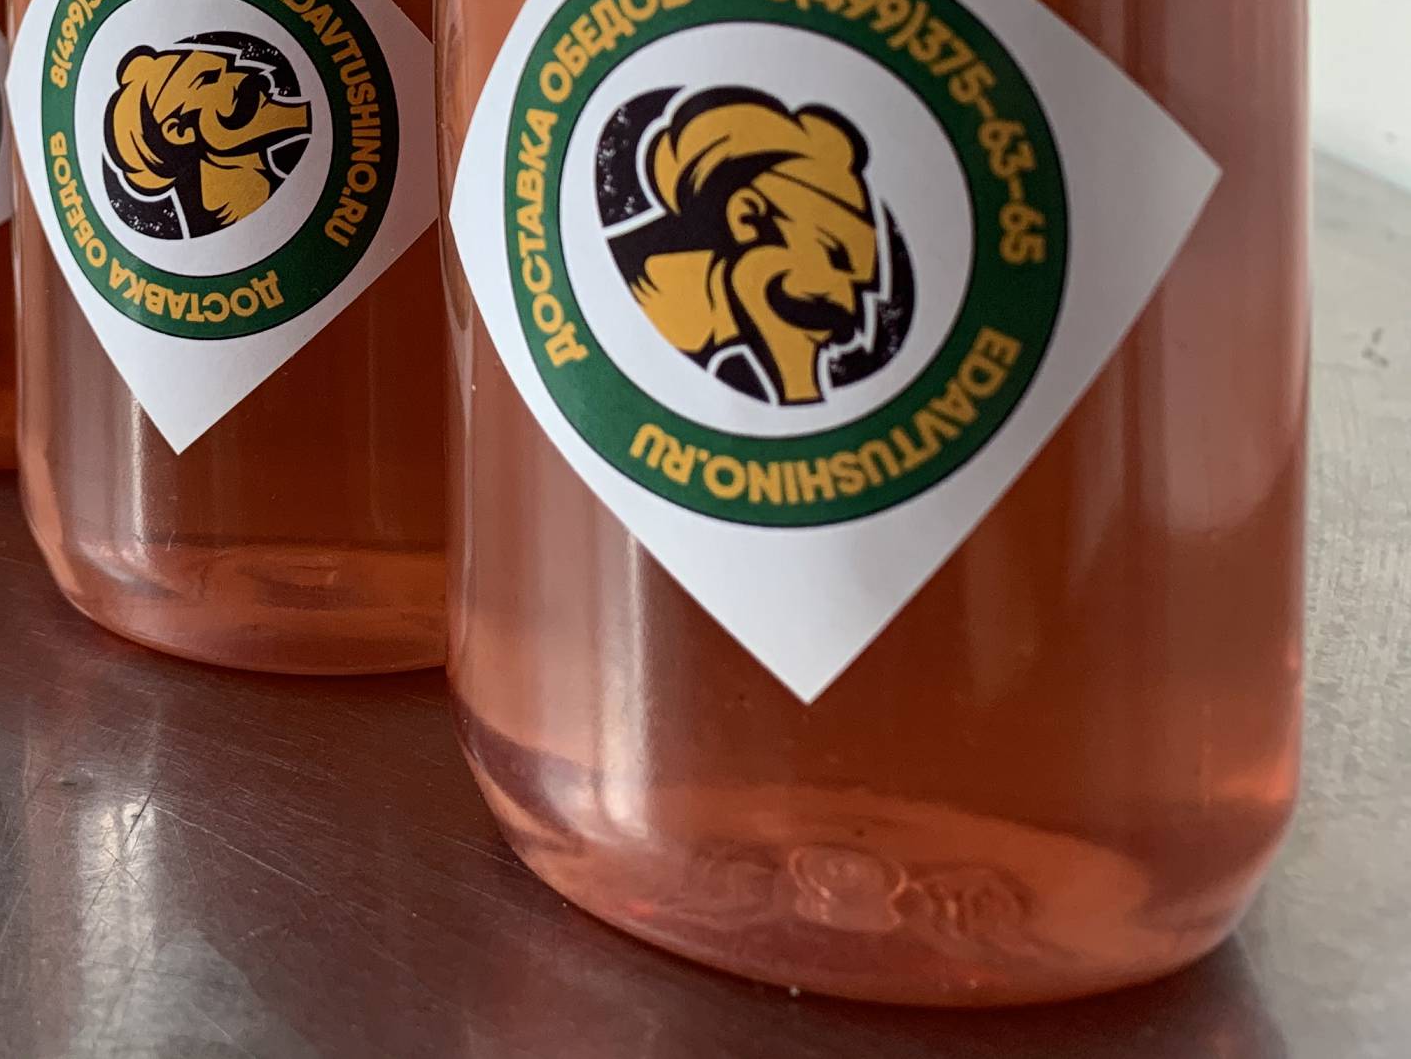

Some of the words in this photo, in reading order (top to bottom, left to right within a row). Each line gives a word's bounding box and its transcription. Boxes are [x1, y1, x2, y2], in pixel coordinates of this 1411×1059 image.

[49, 131, 107, 268] ОБЕДОВ
[516, 109, 589, 368] ДОСТАВКА
[108, 258, 284, 323] ДОСТАВКА
[629, 327, 1021, 505] EDAVTUSHINO.RU
